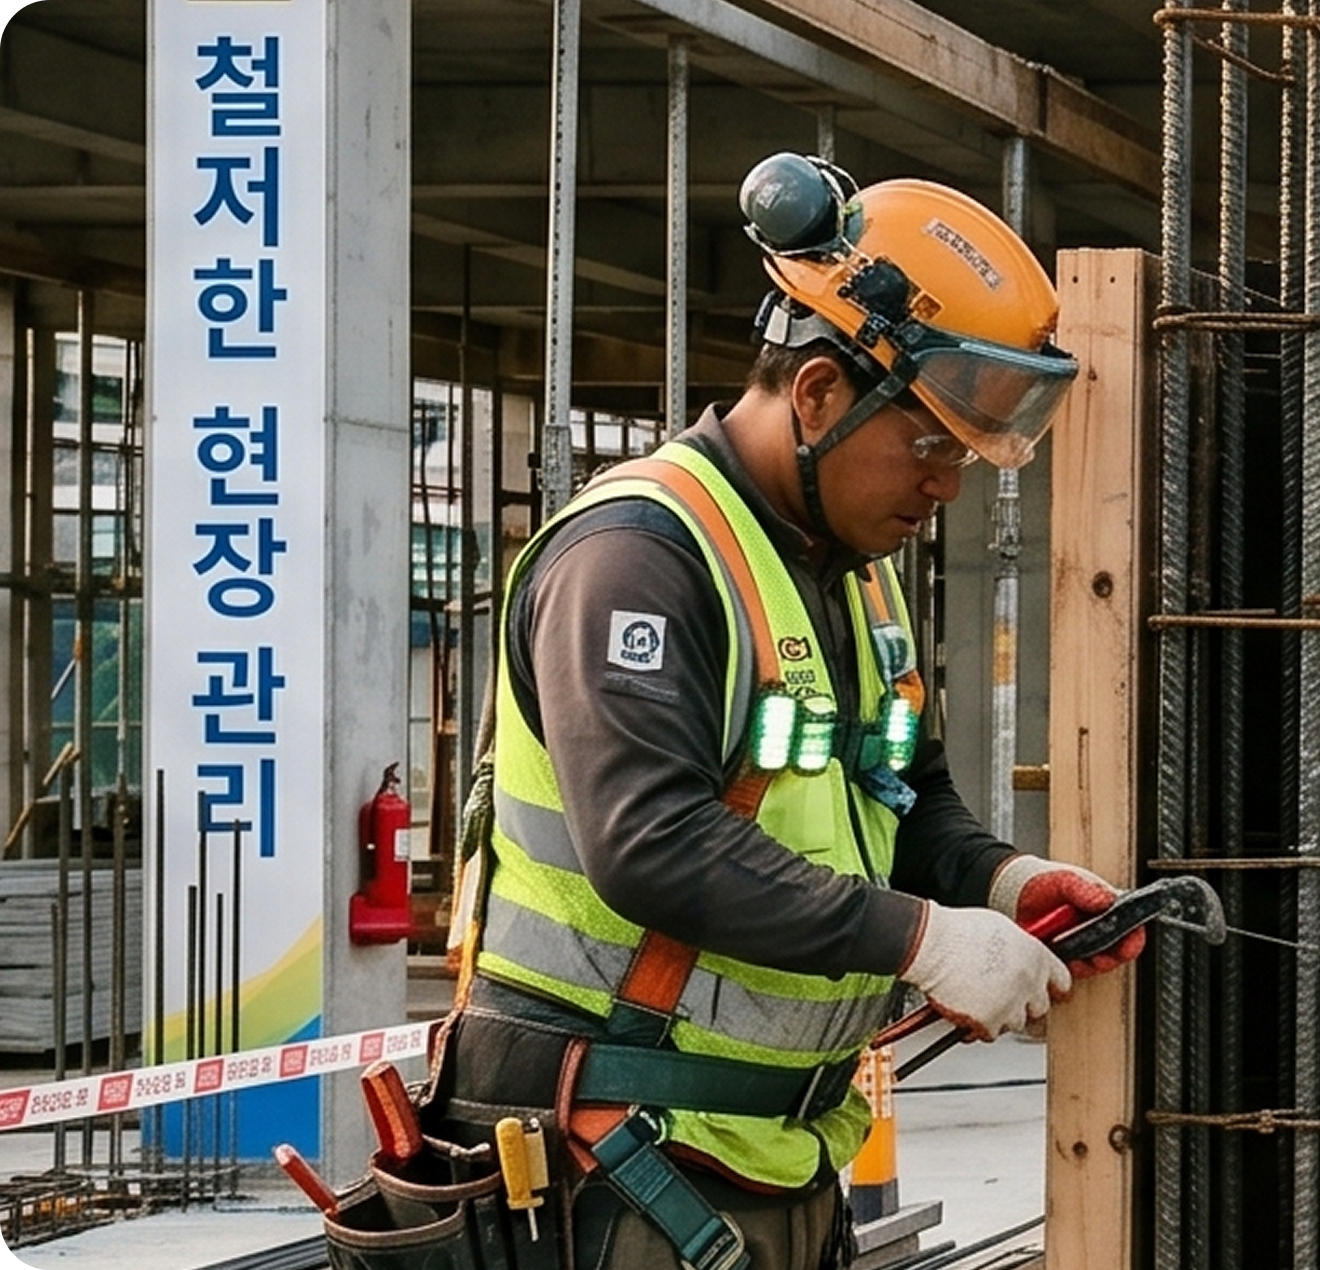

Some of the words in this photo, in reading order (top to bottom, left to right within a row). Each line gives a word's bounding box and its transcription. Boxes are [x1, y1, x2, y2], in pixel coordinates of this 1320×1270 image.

[195, 36, 287, 359] 철저한
[193, 406, 287, 618] 현장
[192, 646, 286, 858] 관리
